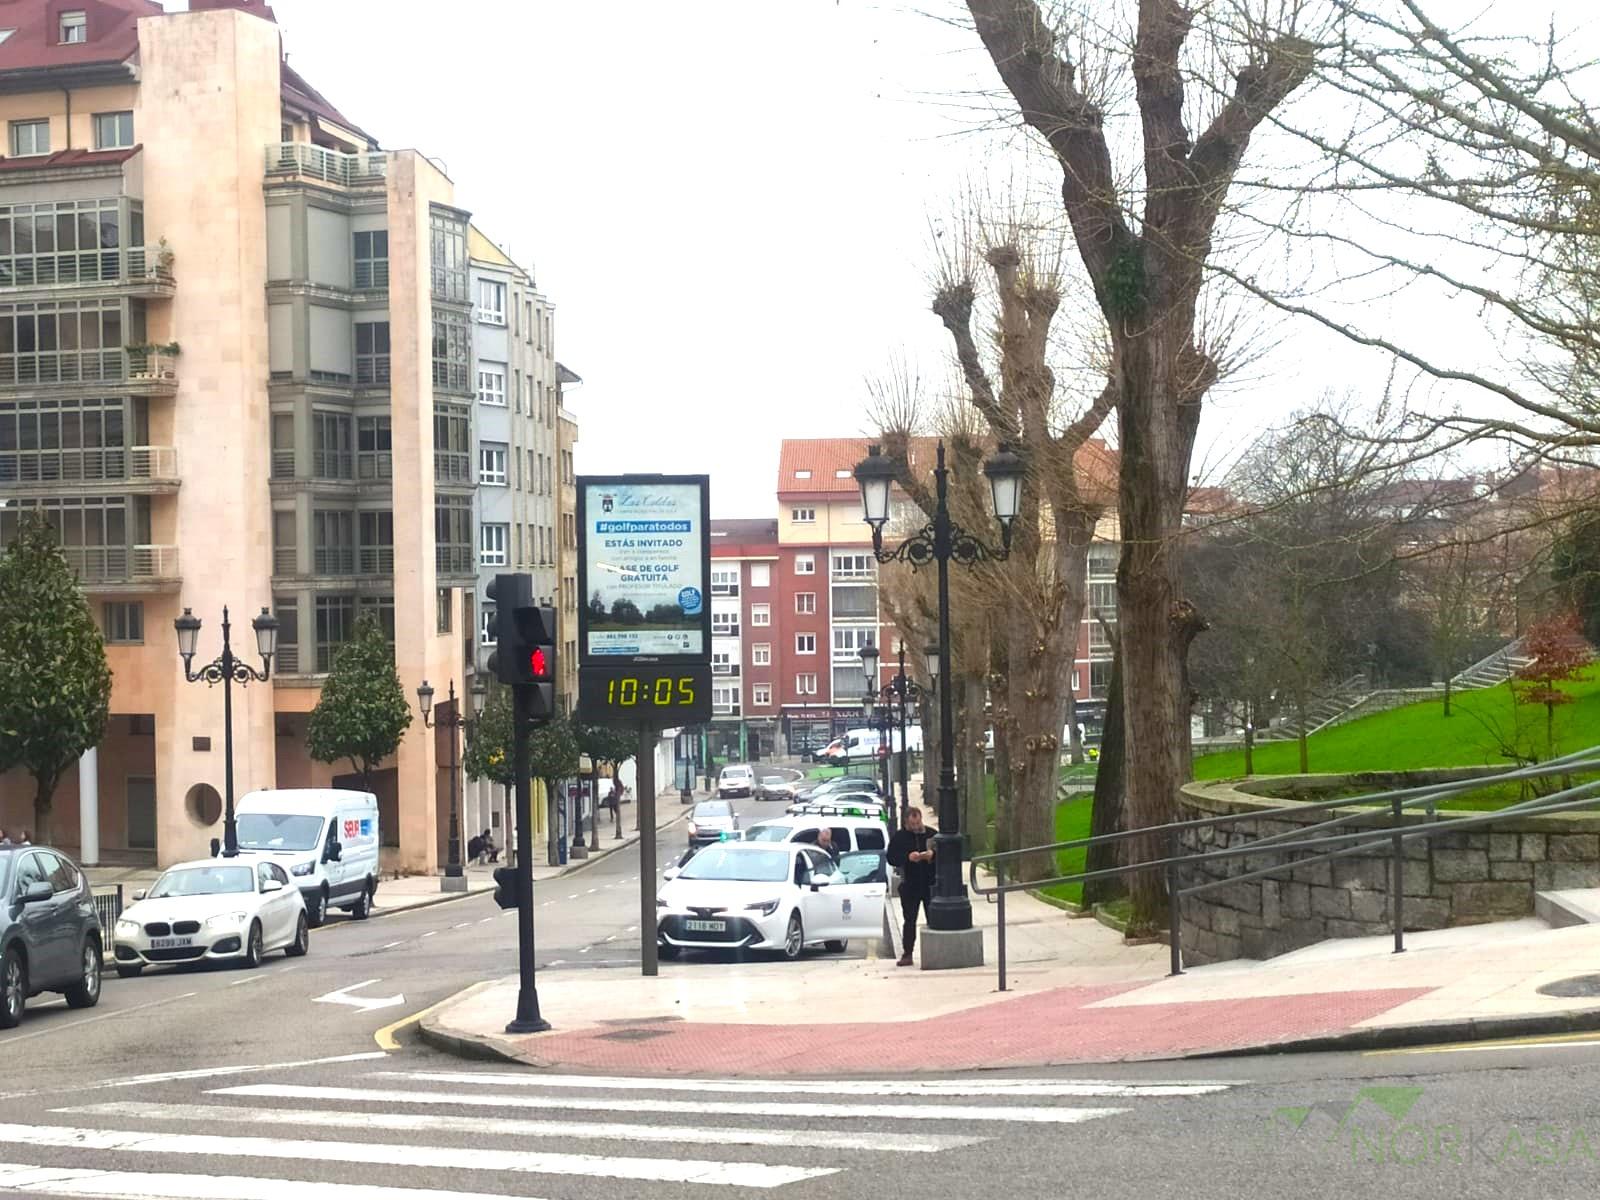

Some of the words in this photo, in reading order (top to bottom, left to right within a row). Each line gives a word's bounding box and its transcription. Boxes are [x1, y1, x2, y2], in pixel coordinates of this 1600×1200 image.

[599, 521, 689, 533] #golfparatodos
[605, 538, 635, 548] ESTÁS
[637, 538, 683, 548] INVITADO
[639, 564, 652, 573] DE
[654, 564, 679, 573] GOLF
[620, 574, 668, 582] GRATUITA
[607, 677, 695, 706] 10:05
